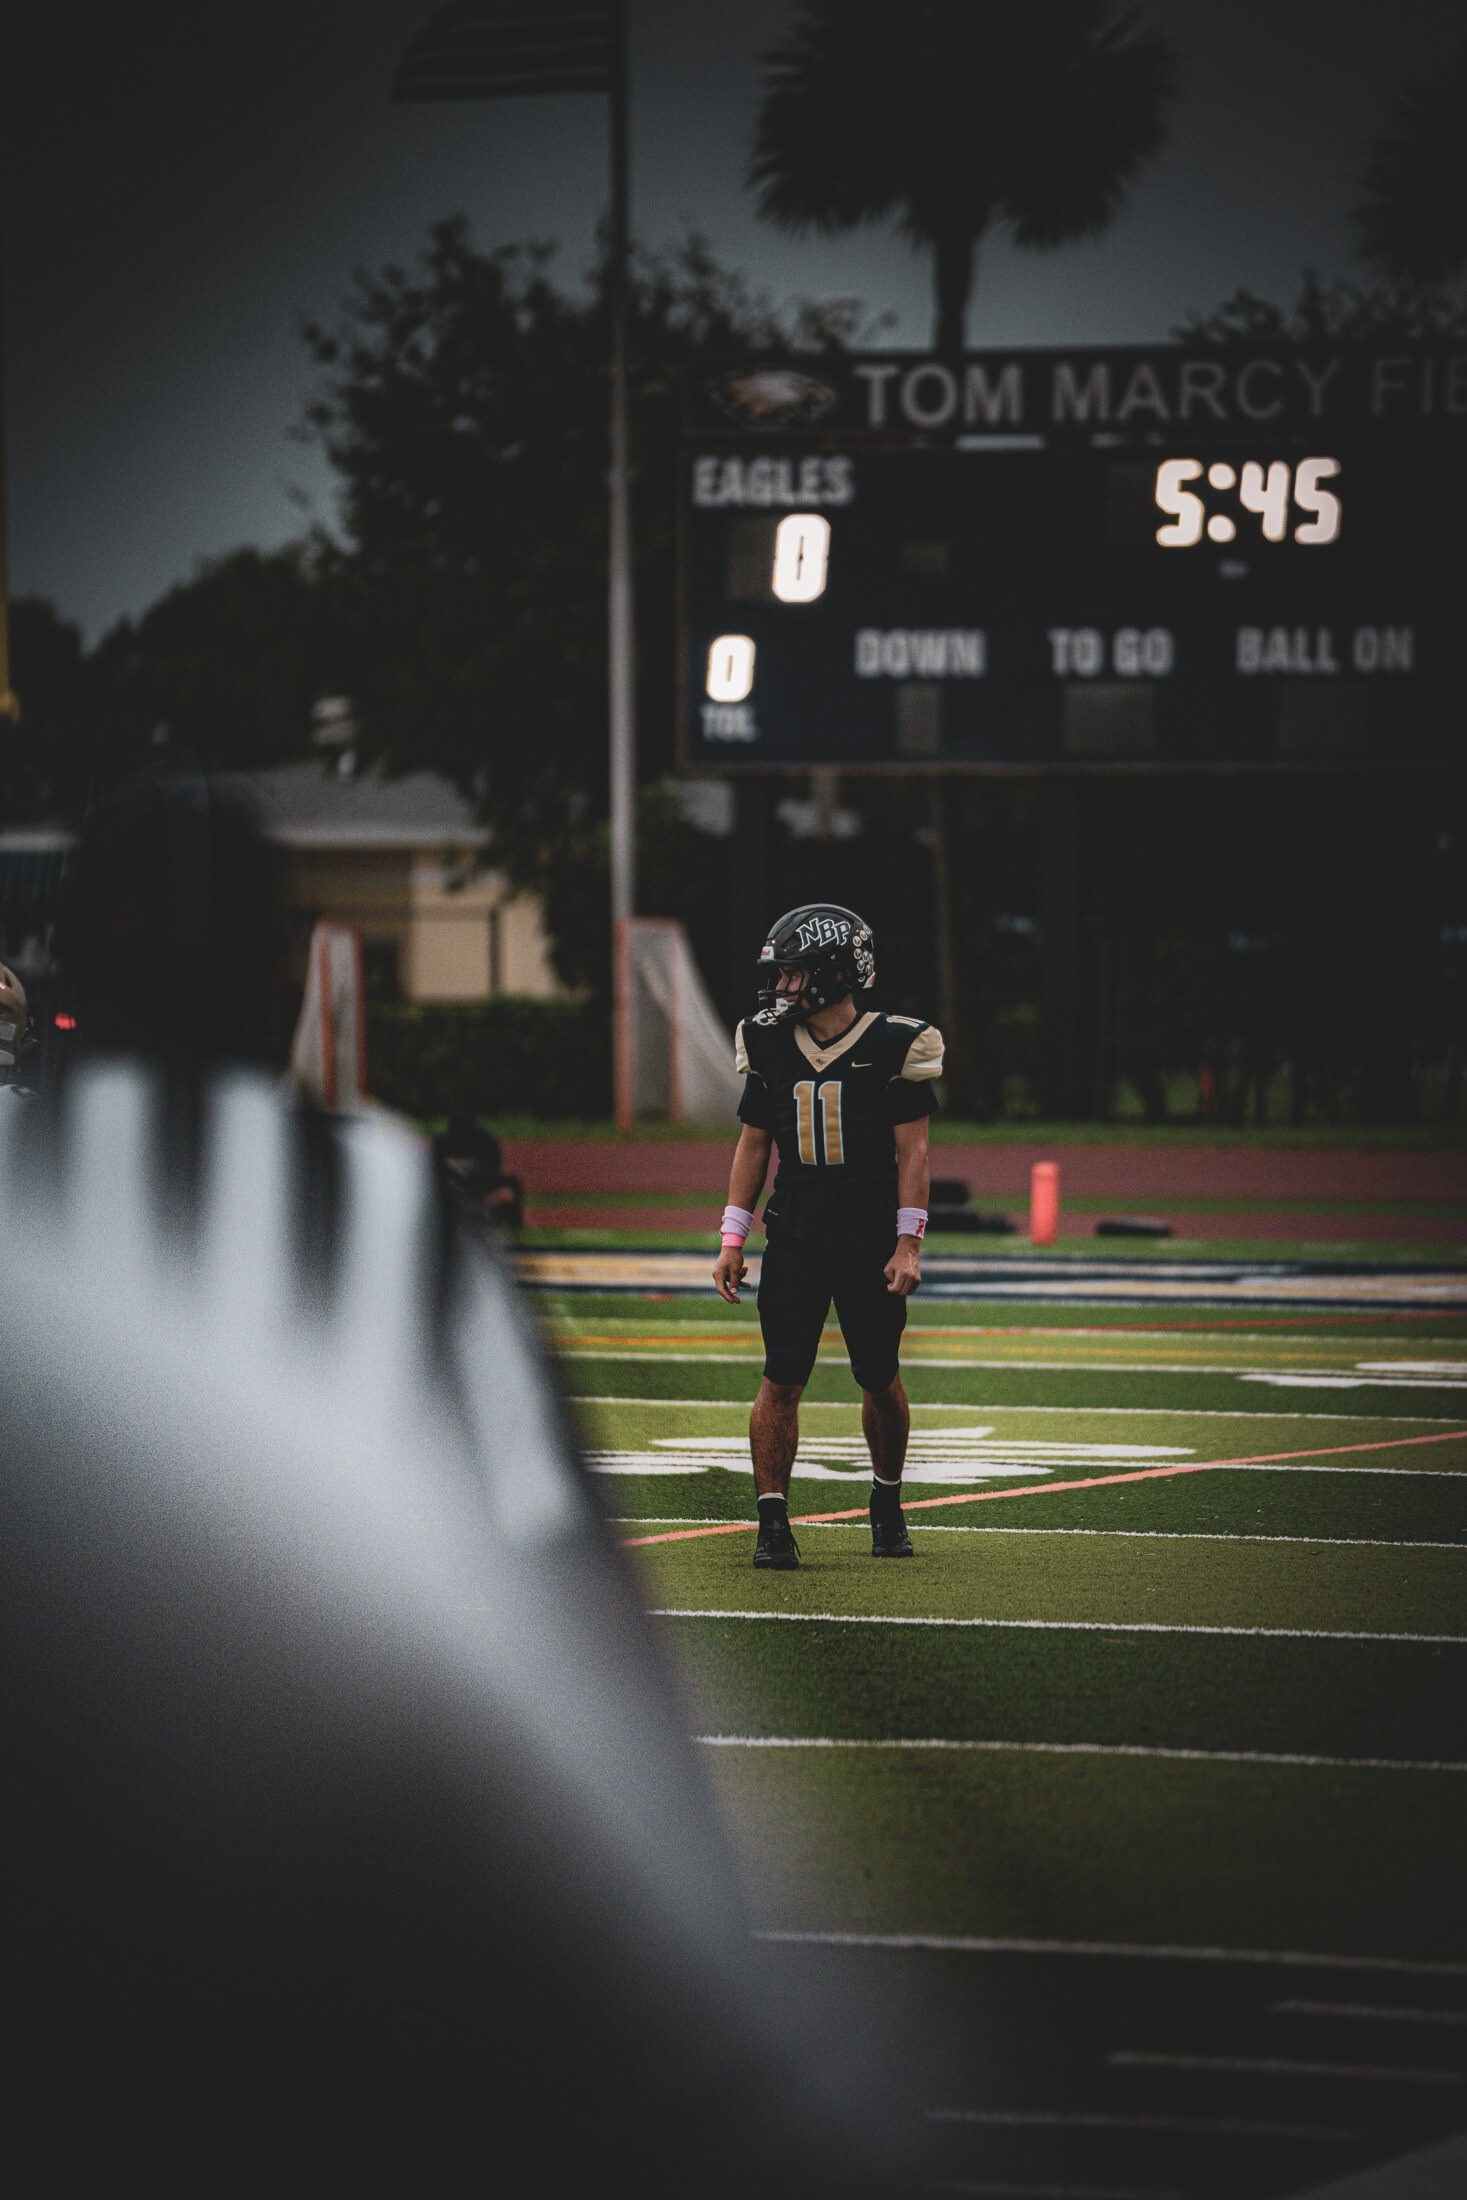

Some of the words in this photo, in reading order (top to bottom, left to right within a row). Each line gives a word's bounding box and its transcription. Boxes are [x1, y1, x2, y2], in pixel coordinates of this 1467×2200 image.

[852, 363, 1022, 428] TOM
[1053, 357, 1339, 421] MARCY
[692, 455, 855, 508] EAGLES
[1155, 457, 1342, 547] 5:45
[772, 514, 831, 603] 0
[706, 635, 756, 702] 0
[854, 626, 986, 678] DOWN
[1046, 627, 1101, 676] TO
[1113, 627, 1174, 677] GO
[1236, 626, 1338, 675] BALL
[1353, 626, 1414, 673] ON
[796, 918, 851, 952] NBP
[794, 1080, 845, 1166] 11
